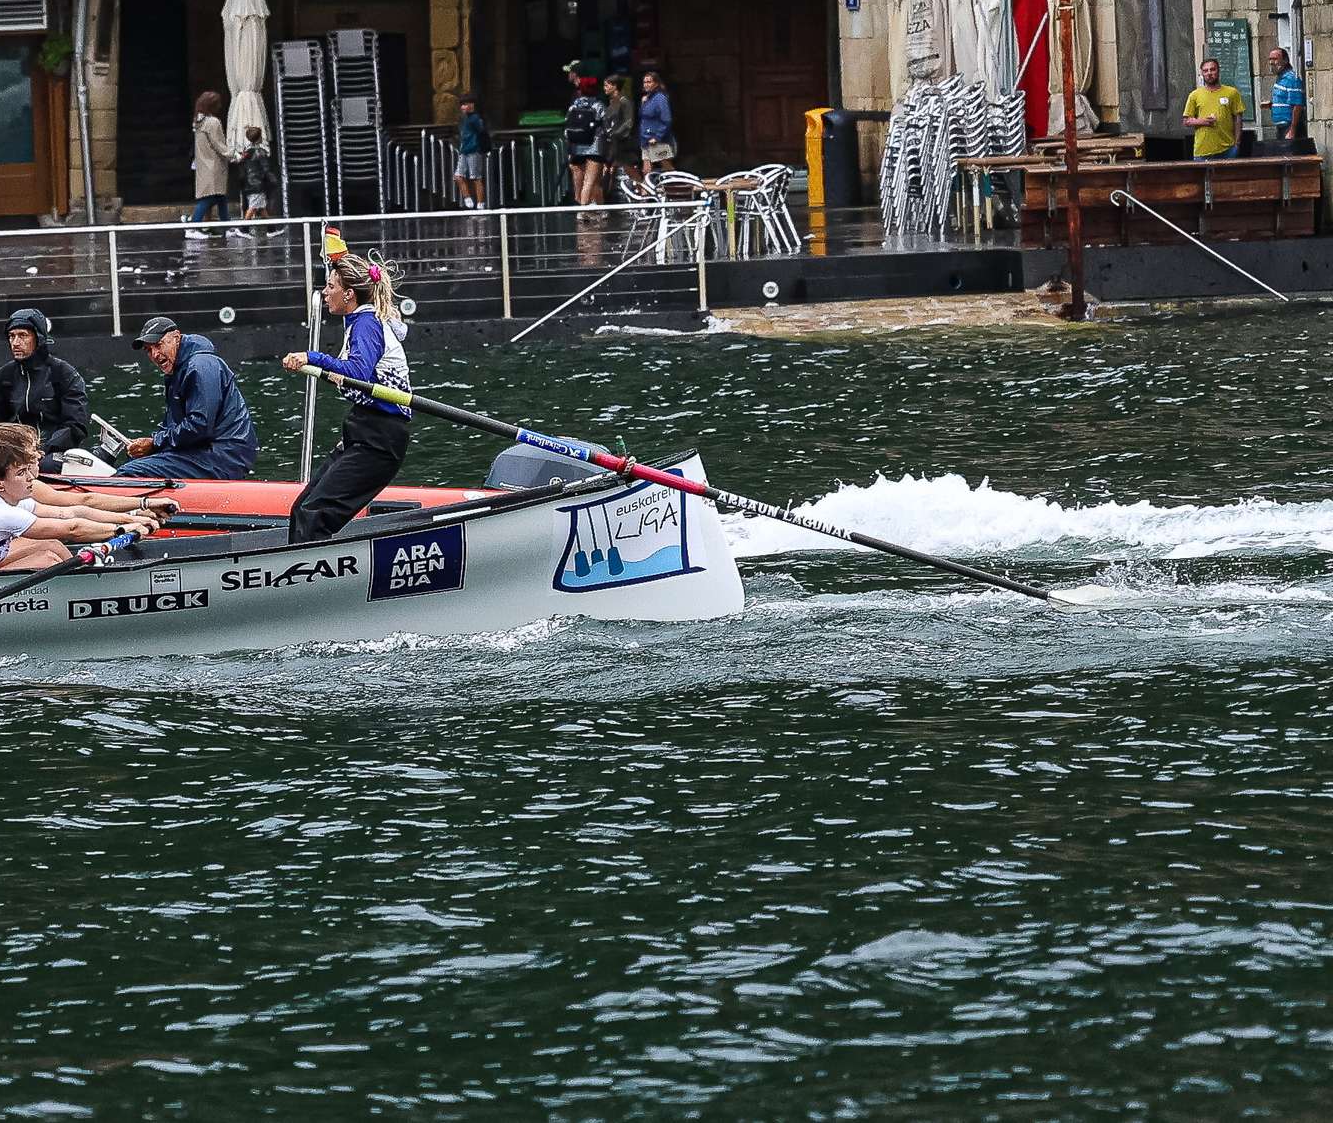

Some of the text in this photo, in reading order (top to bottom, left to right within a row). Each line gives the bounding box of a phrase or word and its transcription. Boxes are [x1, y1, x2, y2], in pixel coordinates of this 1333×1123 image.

[614, 502, 678, 540] LIGA
[717, 490, 854, 541] ARRAUN LAGUNAK
[392, 541, 444, 564] ARA
[390, 558, 446, 579] MEN
[389, 573, 433, 591] DIA
[72, 592, 207, 619] DRUCK
